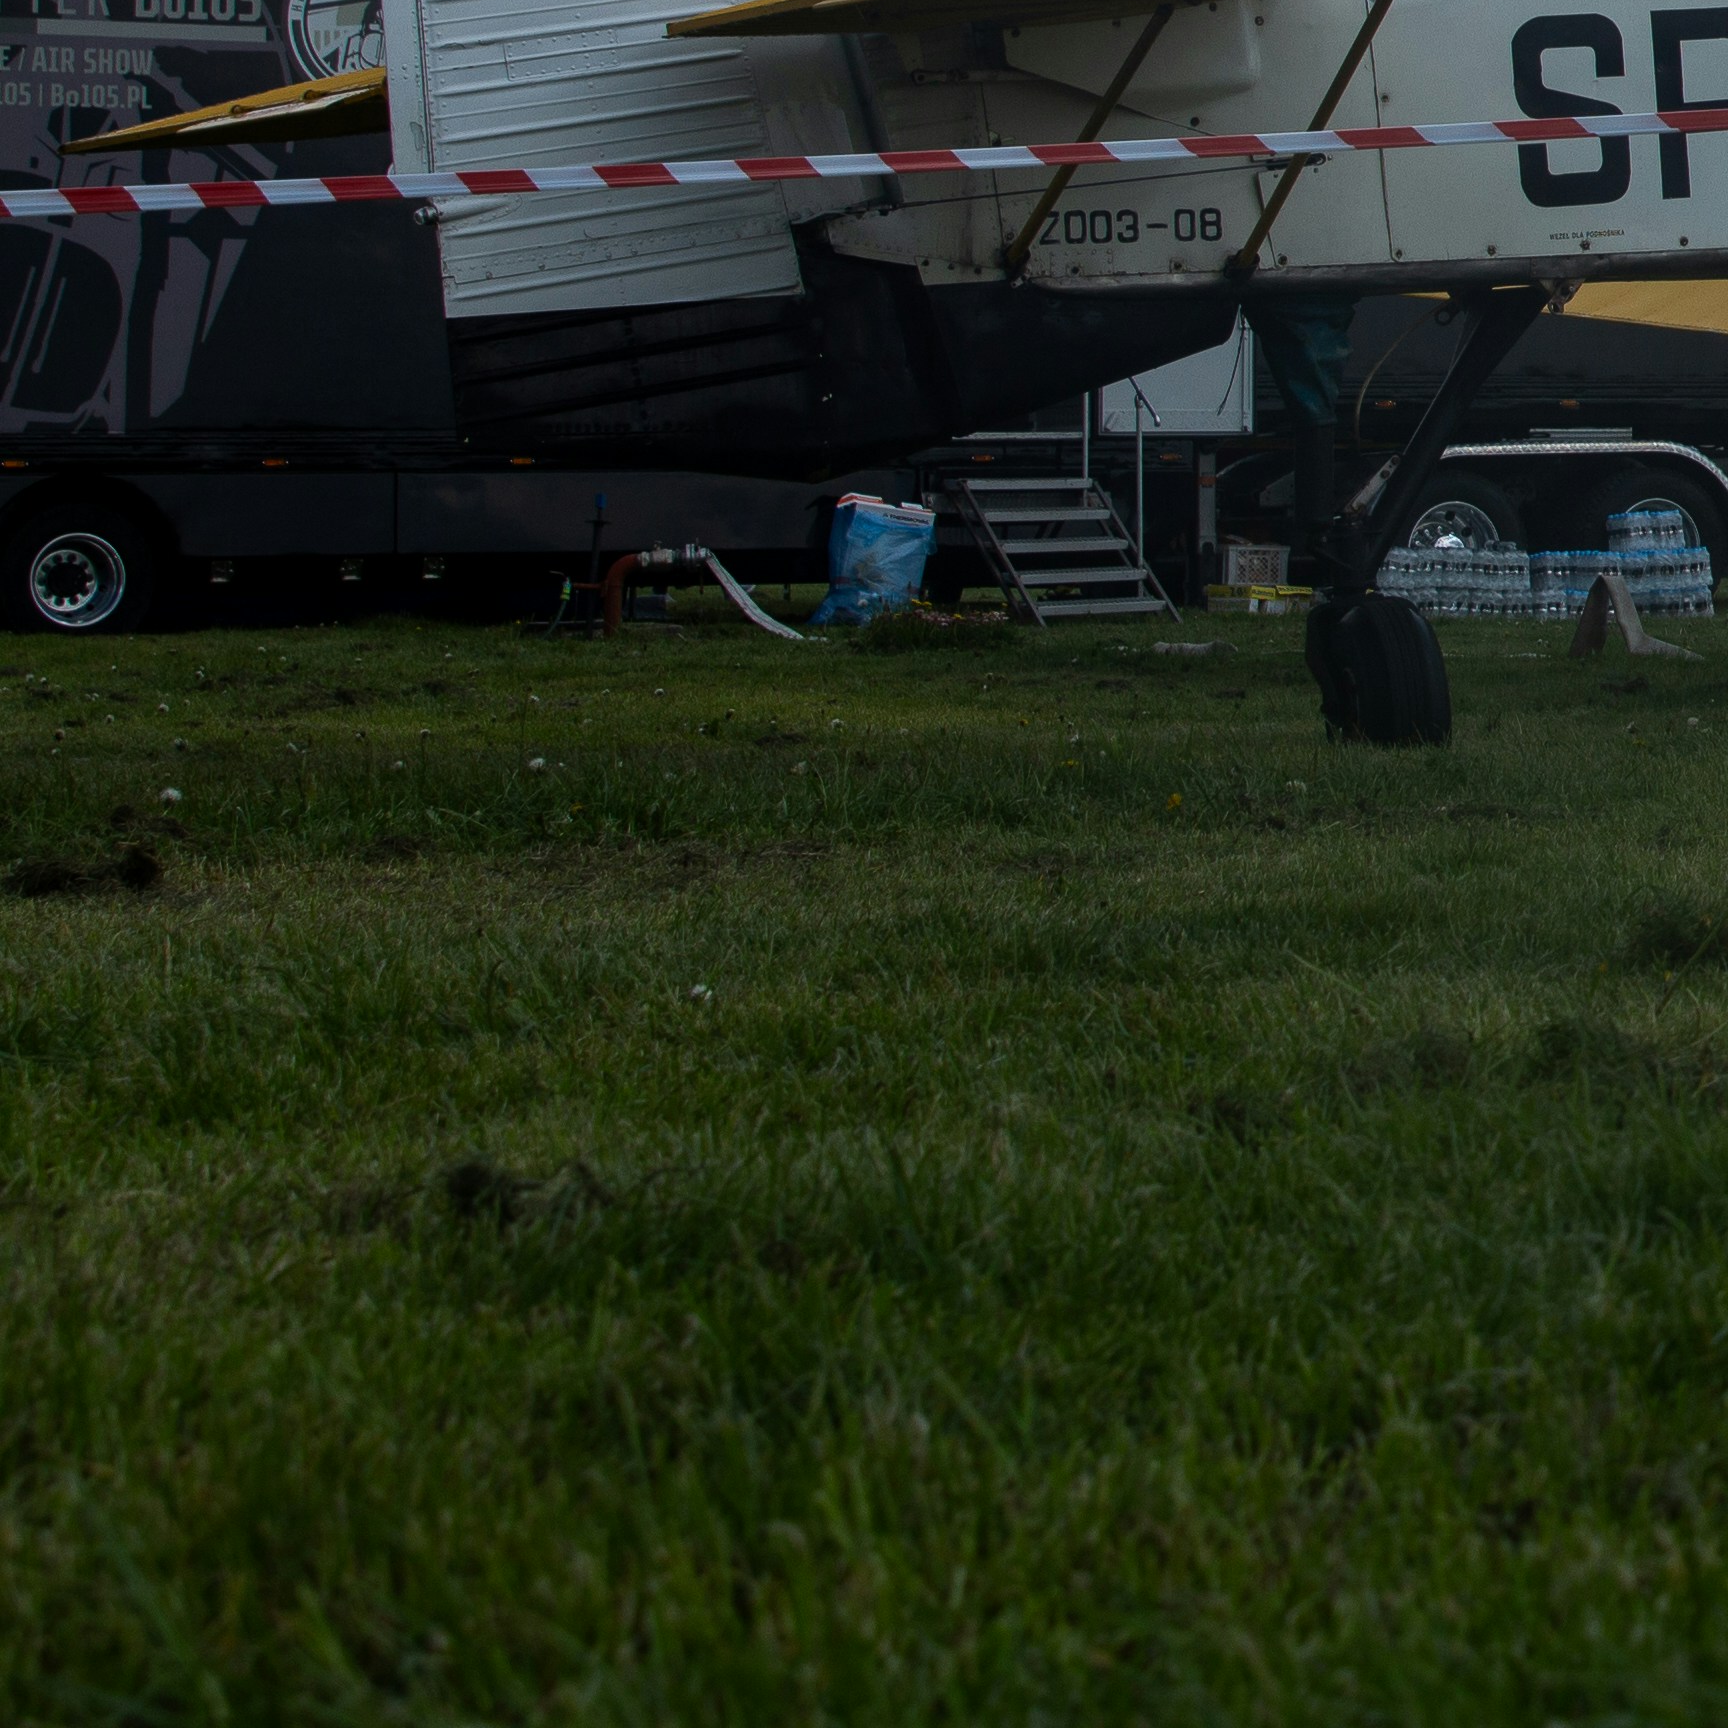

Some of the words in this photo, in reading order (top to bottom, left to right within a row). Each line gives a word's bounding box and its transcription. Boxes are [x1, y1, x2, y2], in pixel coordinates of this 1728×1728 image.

[32, 47, 75, 73] AIR
[84, 48, 153, 76] SHOW
[51, 83, 153, 109] Bo105.PL
